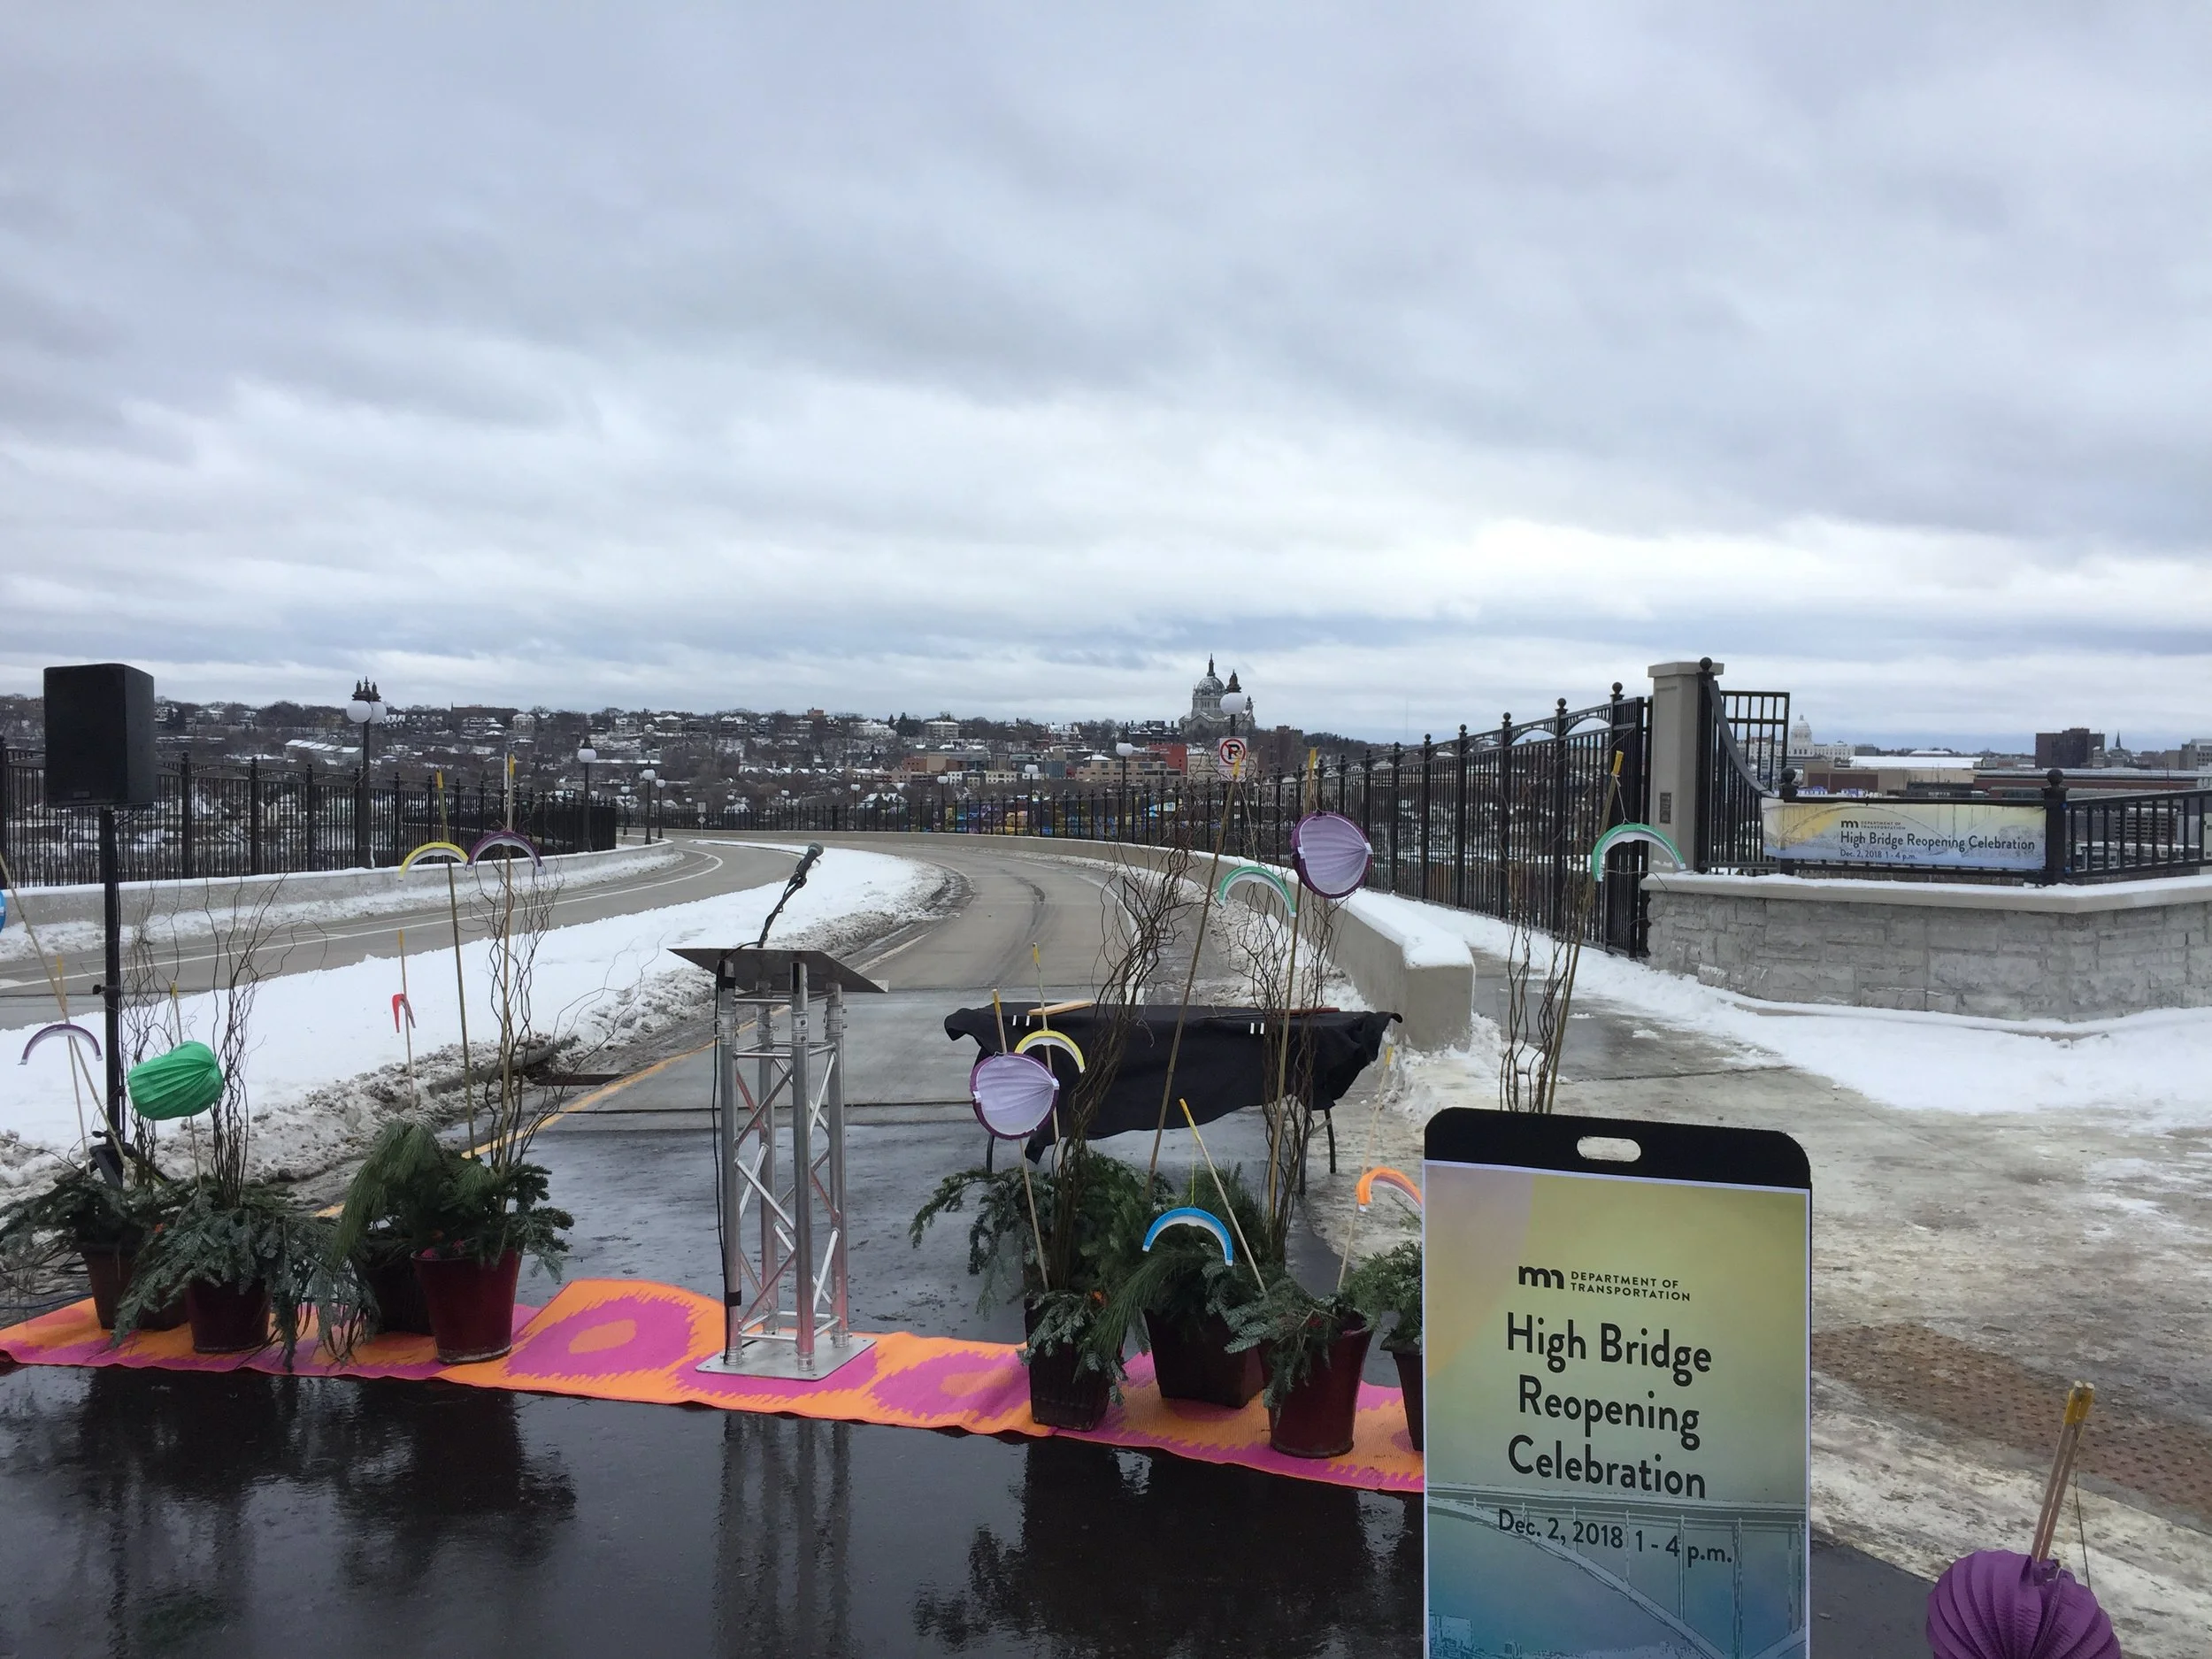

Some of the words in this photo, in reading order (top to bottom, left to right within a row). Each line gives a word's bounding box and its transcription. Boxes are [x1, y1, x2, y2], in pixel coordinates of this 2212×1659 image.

[1840, 831, 1866, 849] High
[1870, 832, 1904, 850] Bridge
[1907, 833, 1965, 852] Reopening
[1968, 835, 2035, 850] Celebration
[1570, 1281, 1691, 1302] TRANSPORTATION
[1571, 1271, 1657, 1287] DEPARTMENT
[1662, 1279, 1679, 1289] OF
[1507, 1312, 1586, 1373] High
[1600, 1322, 1712, 1387] Bridge
[1518, 1374, 1701, 1451] Reopening
[1508, 1434, 1707, 1501] Celebration
[1498, 1508, 1541, 1538] Dec.
[1548, 1517, 1566, 1547] 2,
[1572, 1521, 1624, 1549] 2018
[1635, 1530, 1643, 1553] 1
[1664, 1535, 1681, 1557] 4
[1687, 1545, 1733, 1569] p.m.
